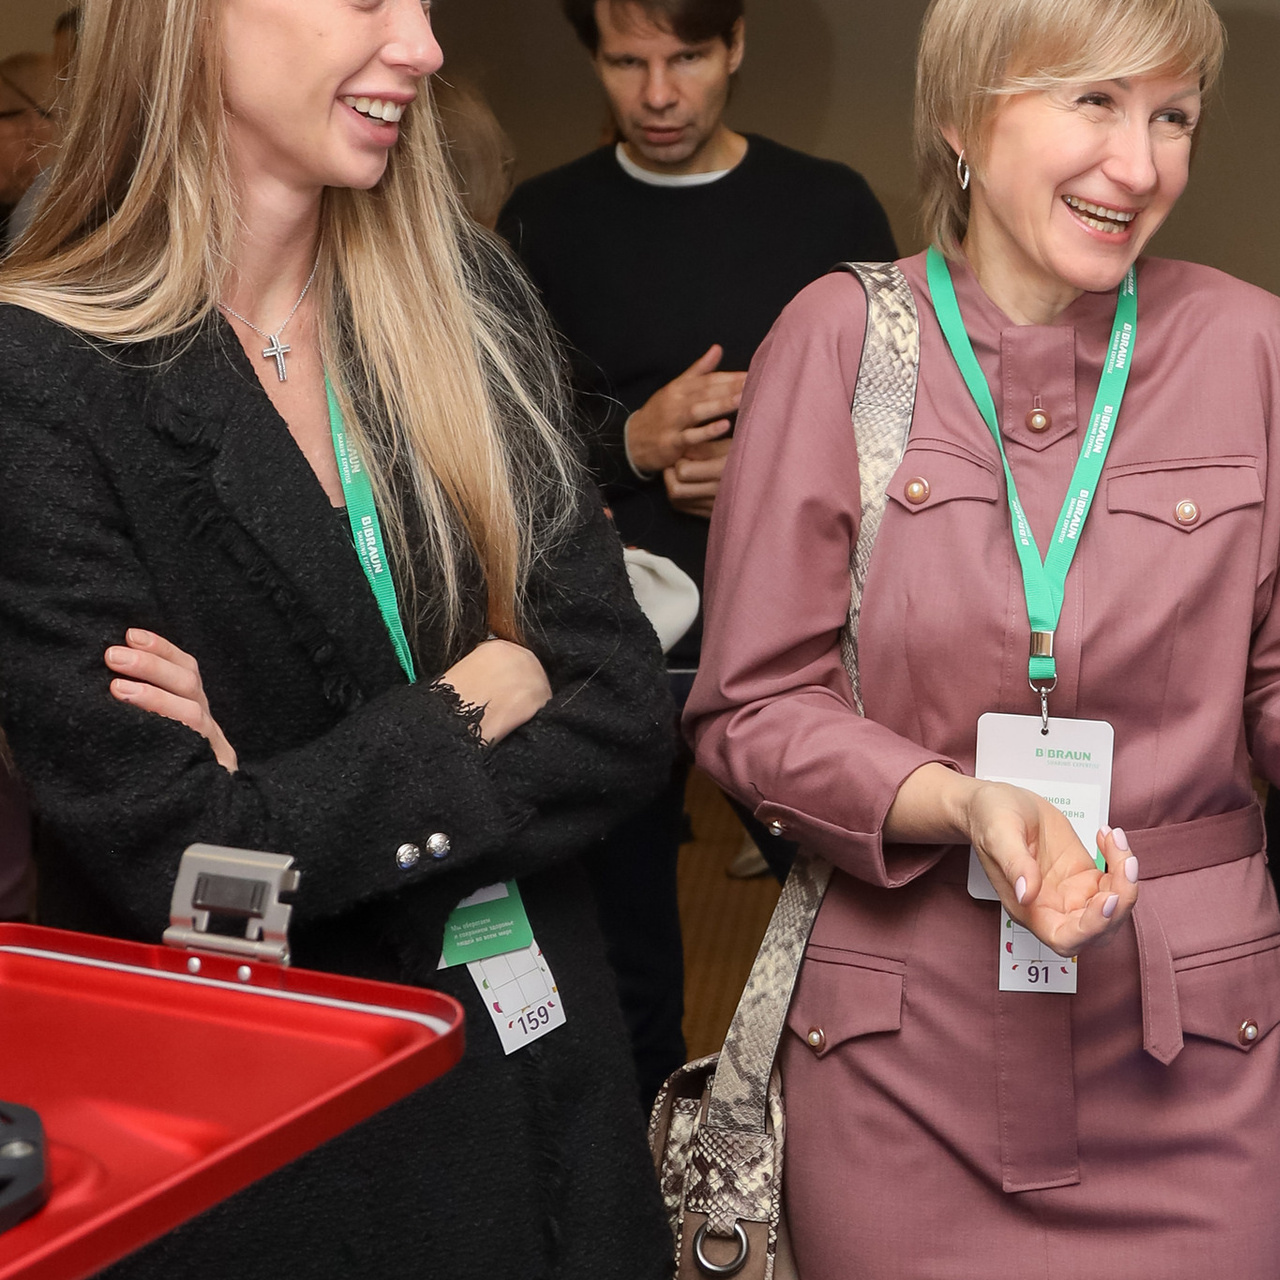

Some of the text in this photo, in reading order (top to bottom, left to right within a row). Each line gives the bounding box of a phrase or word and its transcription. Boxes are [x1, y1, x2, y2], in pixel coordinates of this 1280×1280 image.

[1062, 809, 1085, 819] овна
[1027, 965, 1049, 984] 91
[517, 1005, 550, 1035] 159
